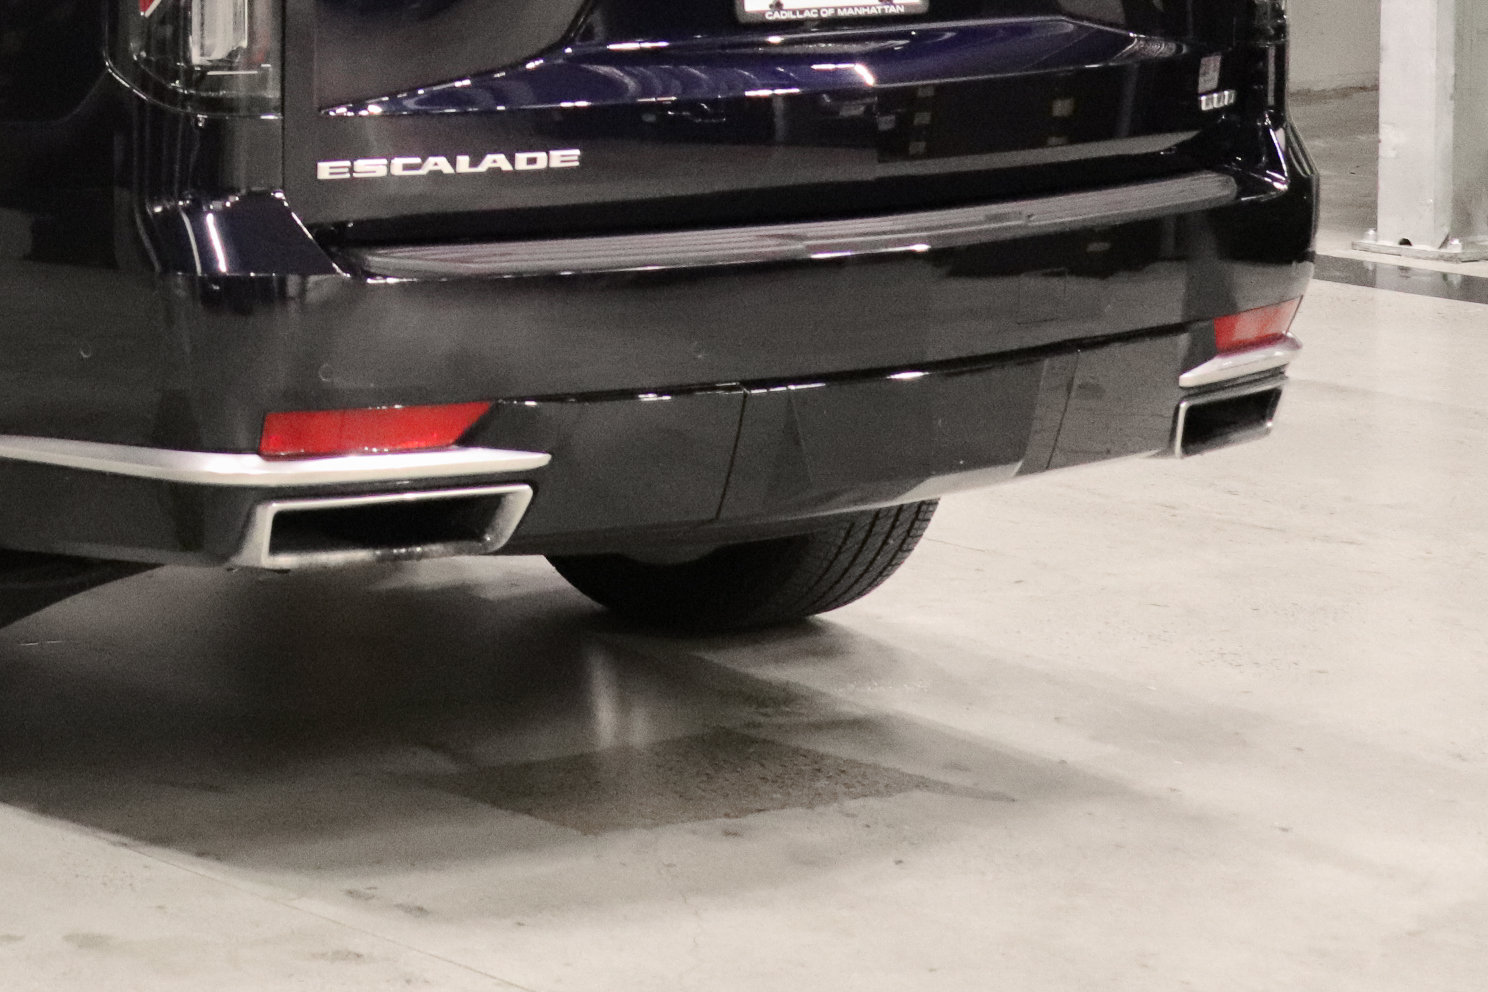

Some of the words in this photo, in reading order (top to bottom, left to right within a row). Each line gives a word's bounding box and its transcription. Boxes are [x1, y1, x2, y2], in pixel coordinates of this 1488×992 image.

[765, 8, 818, 20] CADILLAC
[820, 8, 835, 18] OF
[837, 5, 905, 17] MANHATTAN
[317, 149, 581, 179] ESCALADE
